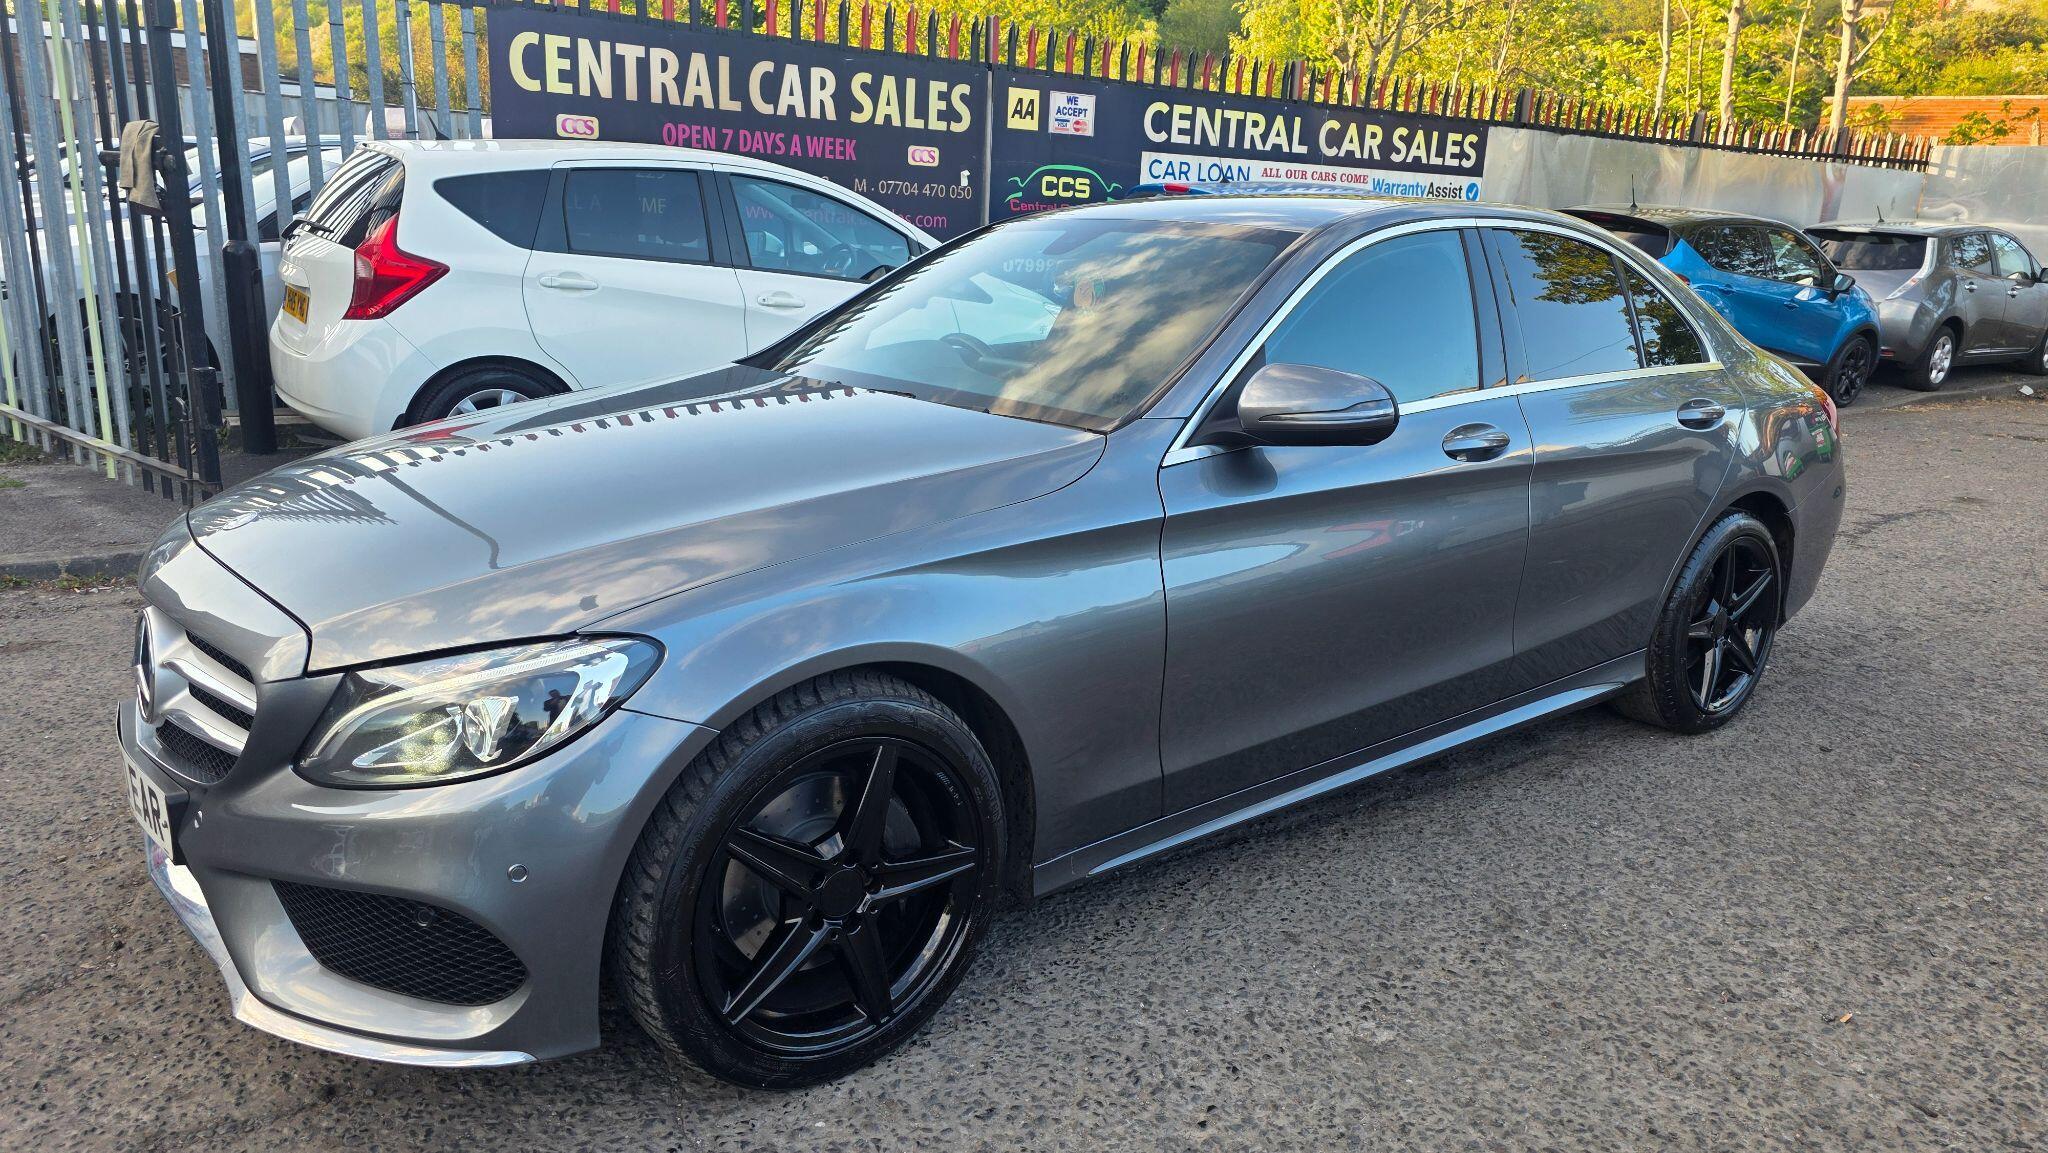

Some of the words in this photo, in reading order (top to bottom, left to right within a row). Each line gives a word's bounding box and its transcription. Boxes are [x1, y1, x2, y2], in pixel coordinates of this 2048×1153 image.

[509, 31, 741, 112] CENTRAL
[749, 60, 837, 121] CAR
[850, 72, 971, 133] SALES
[1011, 97, 1034, 120] AA
[1056, 105, 1088, 118] ACCEPT
[1066, 95, 1079, 106] WE
[561, 117, 594, 136] CCS
[1143, 101, 1308, 154] CENTRAL
[1318, 120, 1383, 160] CAR
[1390, 127, 1478, 168] SALES
[662, 122, 716, 150] OPEN
[722, 128, 734, 150] 7
[739, 129, 786, 155] DAYS
[790, 134, 802, 157] A
[806, 135, 857, 161] WEEK
[1149, 158, 1191, 181] CAR
[1198, 162, 1250, 182] LOAN
[1261, 167, 1282, 178] ALL
[1285, 169, 1308, 180] OUR
[1311, 171, 1338, 182] CARS
[1340, 173, 1369, 184] COME
[879, 180, 918, 196] 07704
[922, 183, 946, 198] 470
[949, 185, 972, 200] 050
[1041, 175, 1090, 198] CCS
